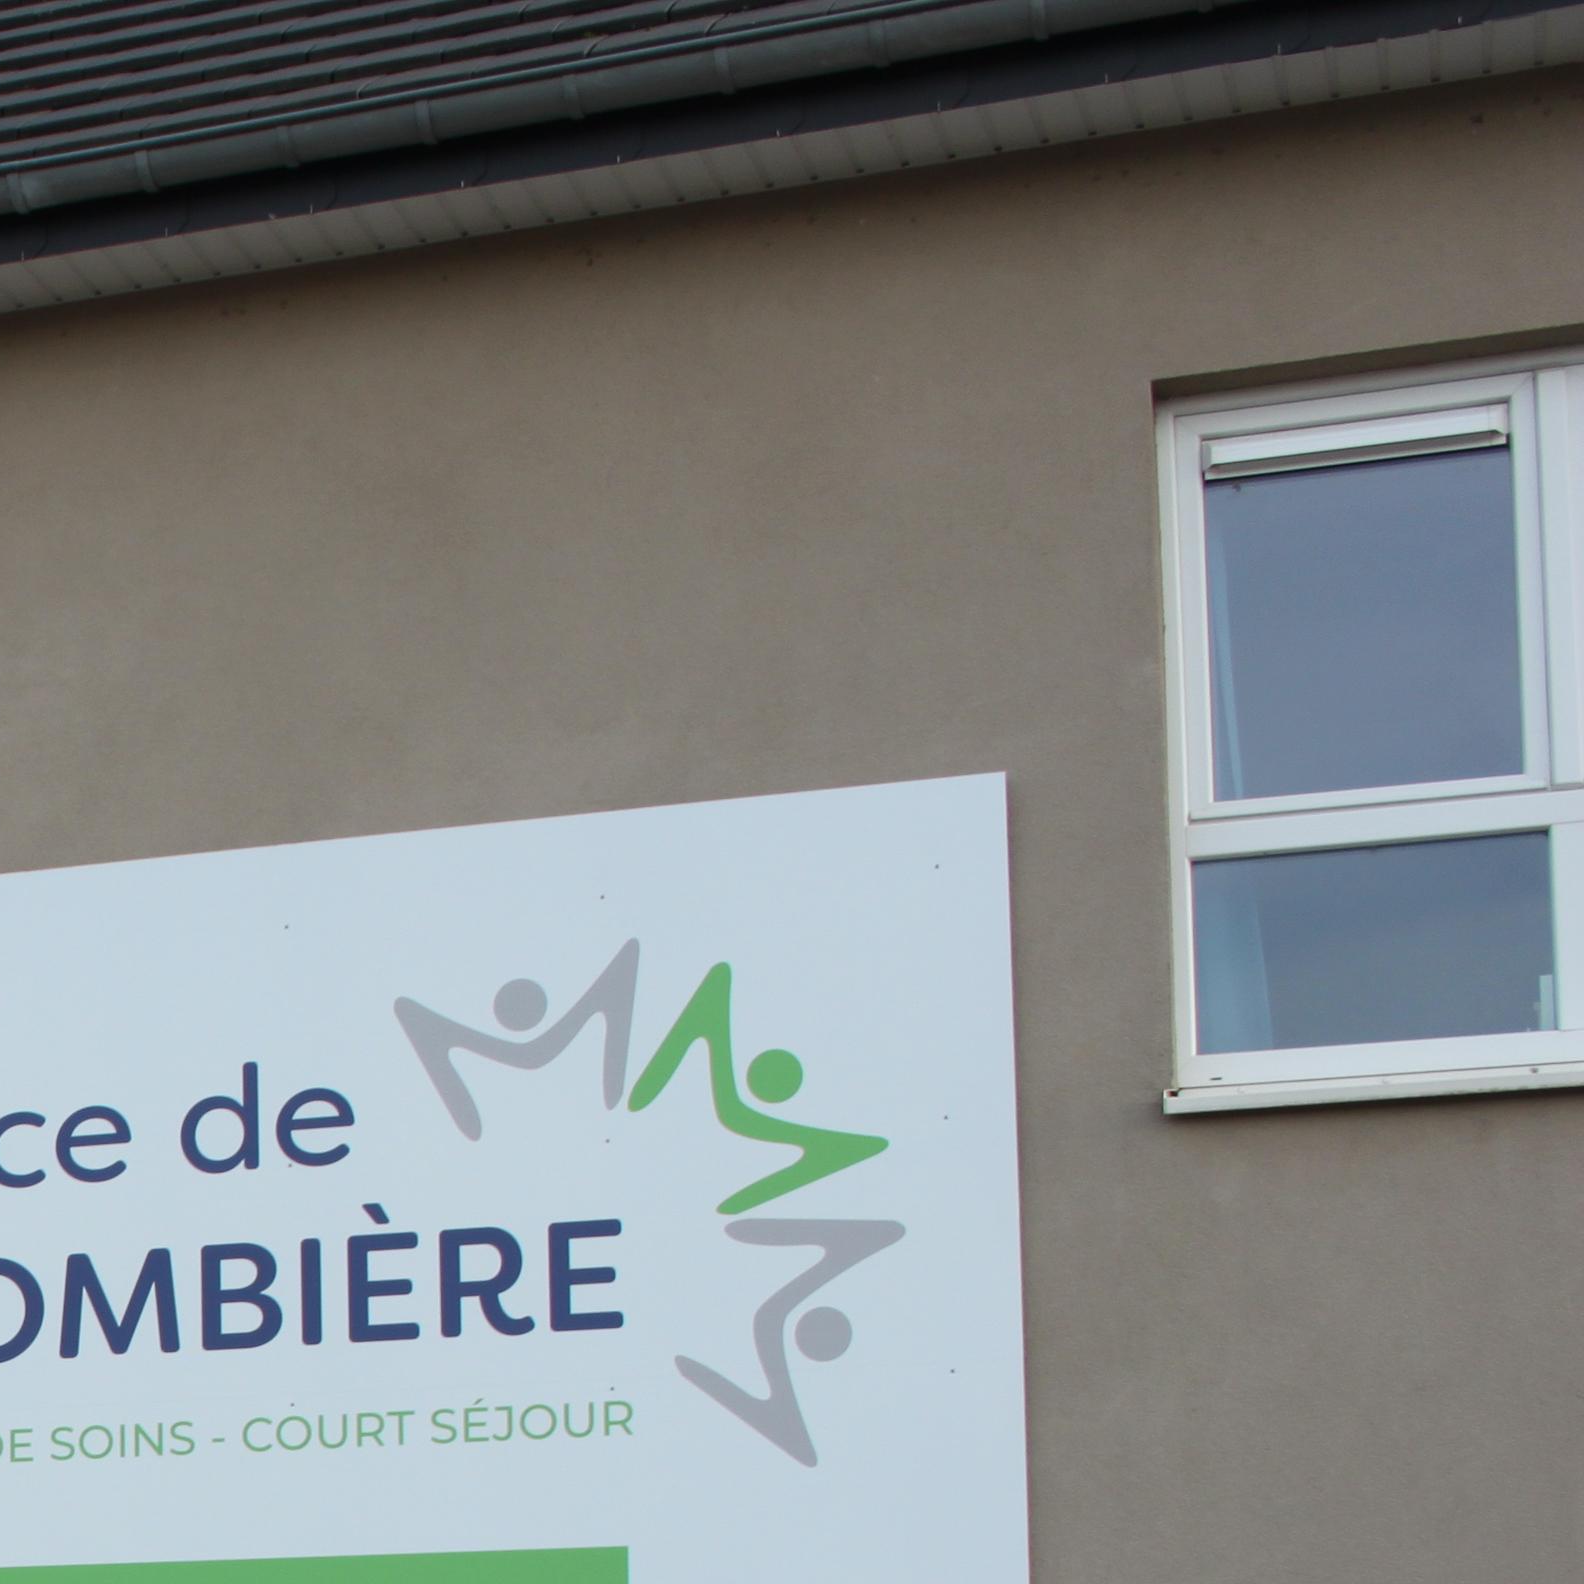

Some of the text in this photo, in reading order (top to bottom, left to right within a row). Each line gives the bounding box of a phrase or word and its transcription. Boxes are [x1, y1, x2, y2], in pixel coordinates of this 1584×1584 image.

[179, 1060, 357, 1175] de
[49, 1420, 198, 1462] SOINS
[241, 1409, 416, 1454] COURT
[430, 1397, 636, 1446] SÉJOUR
